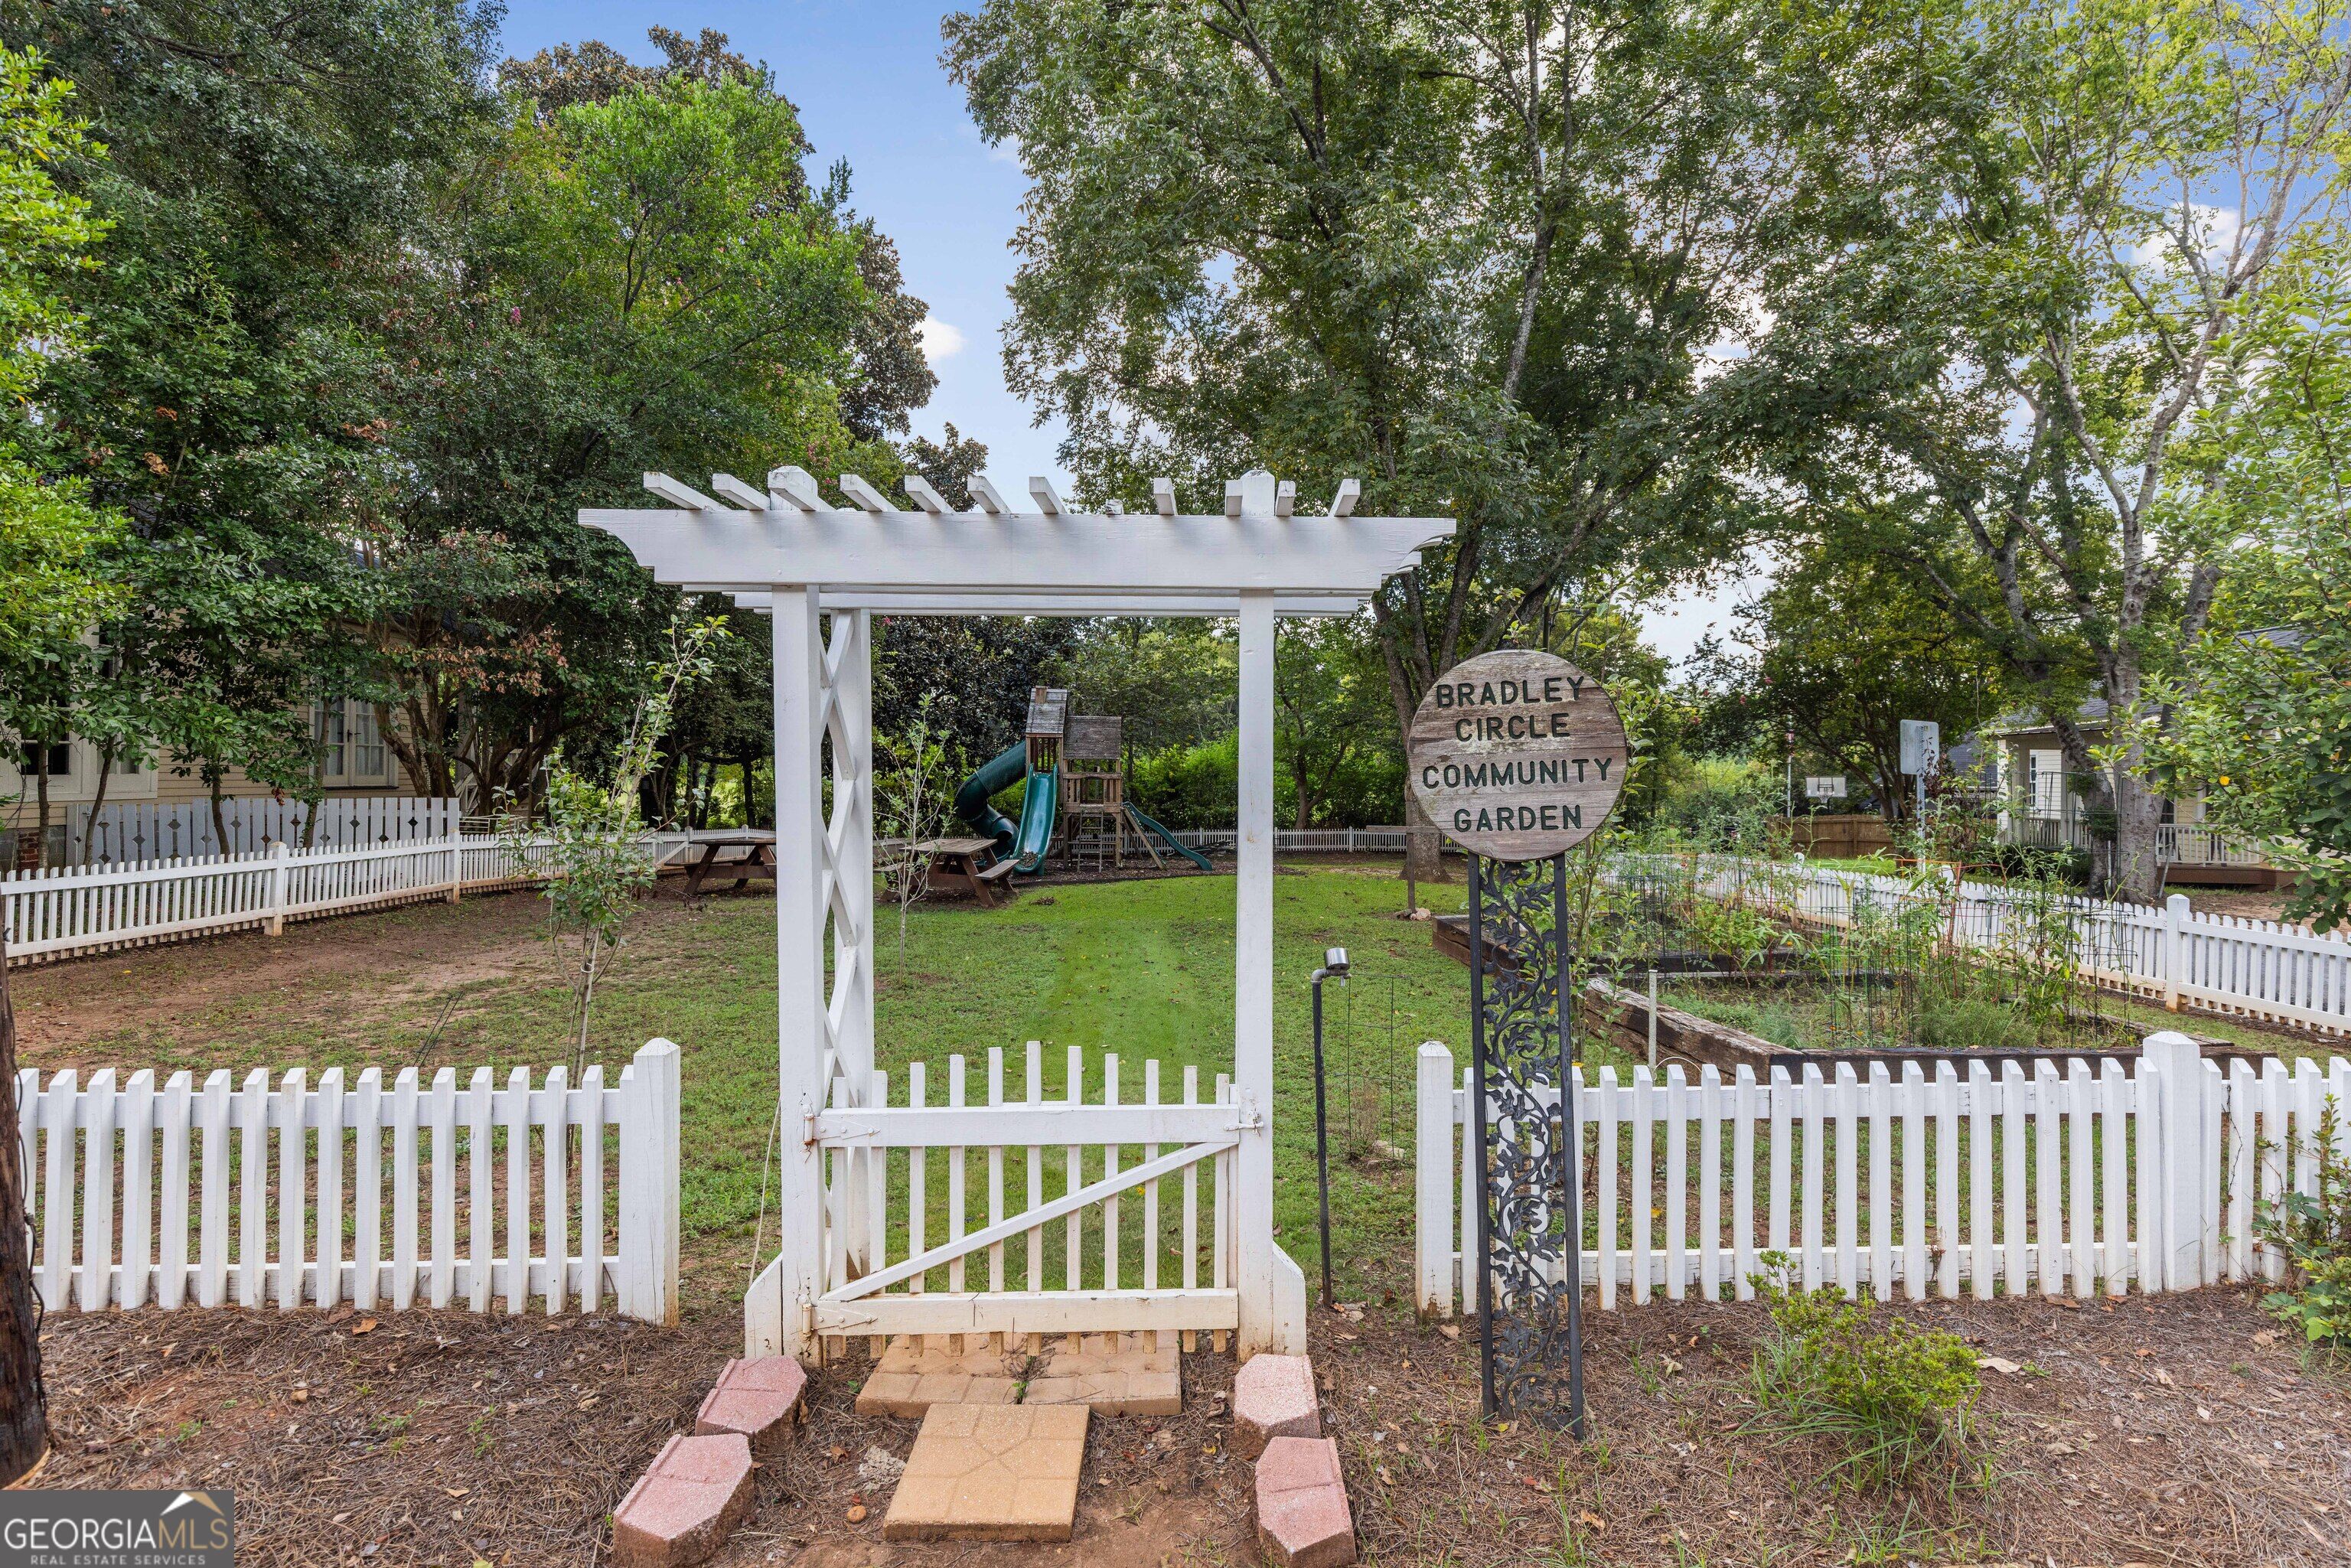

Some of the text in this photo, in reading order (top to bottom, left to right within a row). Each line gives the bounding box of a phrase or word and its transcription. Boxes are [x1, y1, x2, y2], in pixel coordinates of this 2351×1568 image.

[1436, 676, 1584, 709] BRADLEY
[1456, 712, 1570, 742] CIRCLE
[1423, 758, 1612, 789] COMMUNITY
[1454, 804, 1582, 833] GARDEN
